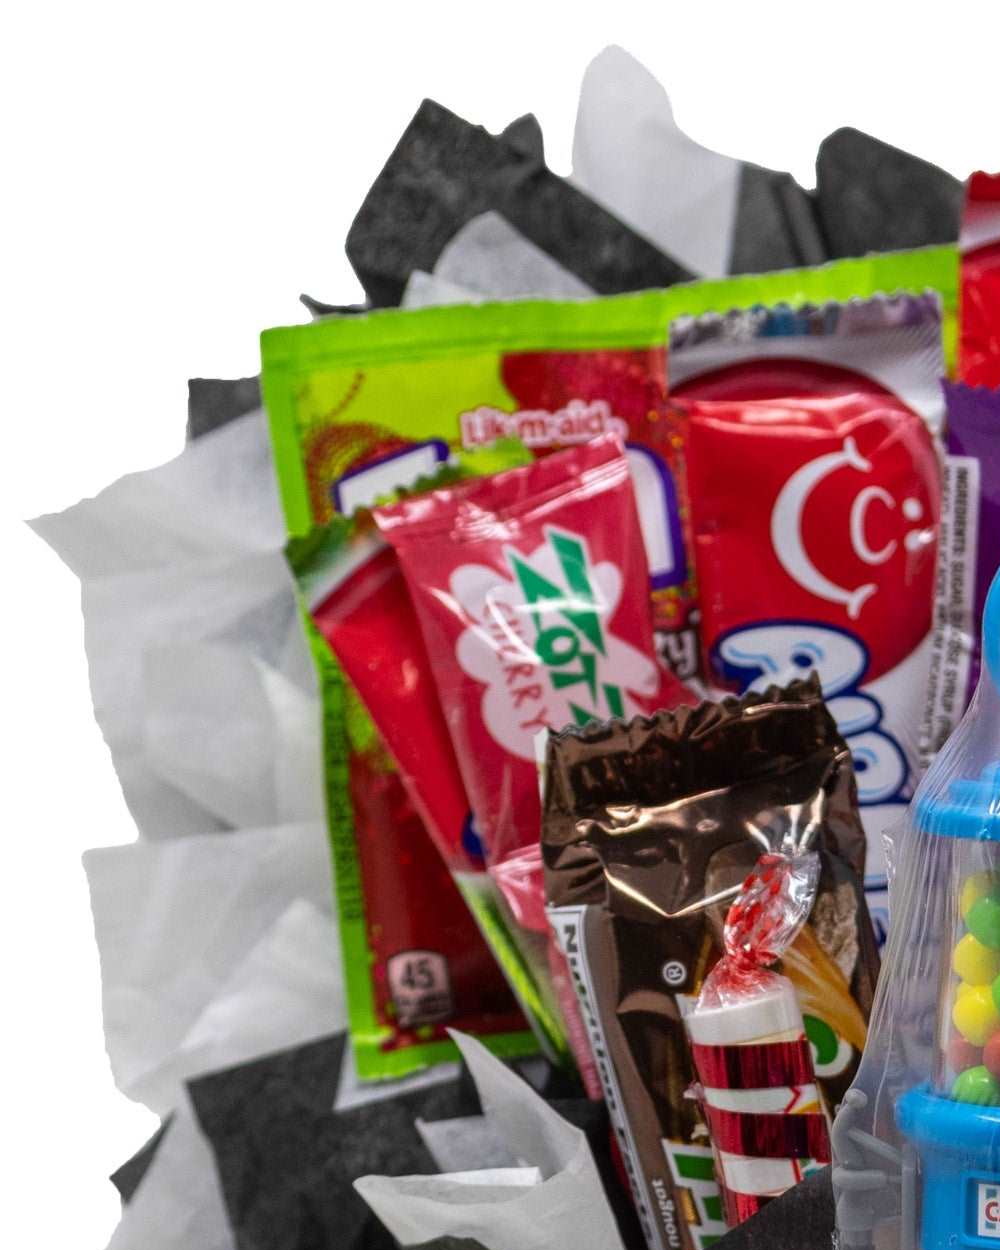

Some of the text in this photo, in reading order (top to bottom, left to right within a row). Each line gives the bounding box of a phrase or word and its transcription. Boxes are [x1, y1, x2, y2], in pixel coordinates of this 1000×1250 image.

[951, 467, 969, 557] INGREDIENTS:
[400, 958, 435, 990] 45
[651, 1178, 680, 1248] nougat
